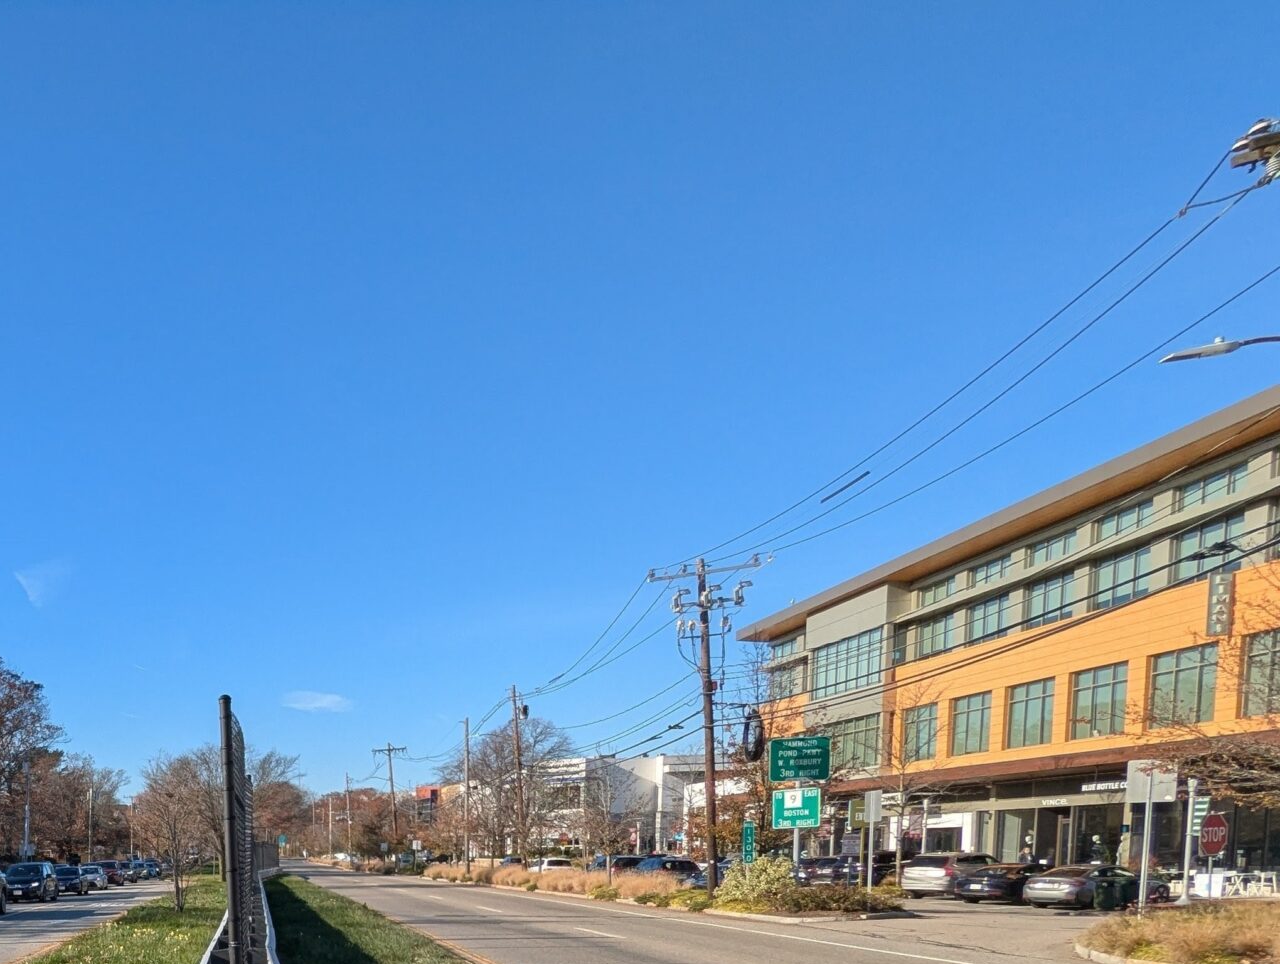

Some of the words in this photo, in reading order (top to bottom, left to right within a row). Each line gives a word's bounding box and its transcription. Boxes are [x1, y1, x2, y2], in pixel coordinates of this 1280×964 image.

[1211, 575, 1230, 632] LIMANI
[778, 750, 798, 758] POND
[789, 758, 822, 767] ROXBURY
[780, 768, 795, 778] 3RD
[799, 768, 819, 777] RIGHT
[1081, 783, 1097, 792] BLUE
[1096, 782, 1120, 791] BOTTLE
[775, 792, 783, 800] TO
[790, 794, 797, 804] 9
[804, 789, 818, 798] EAST
[784, 809, 809, 817] BOSTON
[778, 819, 792, 827] 3RD
[795, 818, 816, 826] RIGHT
[1202, 826, 1225, 842] STOP
